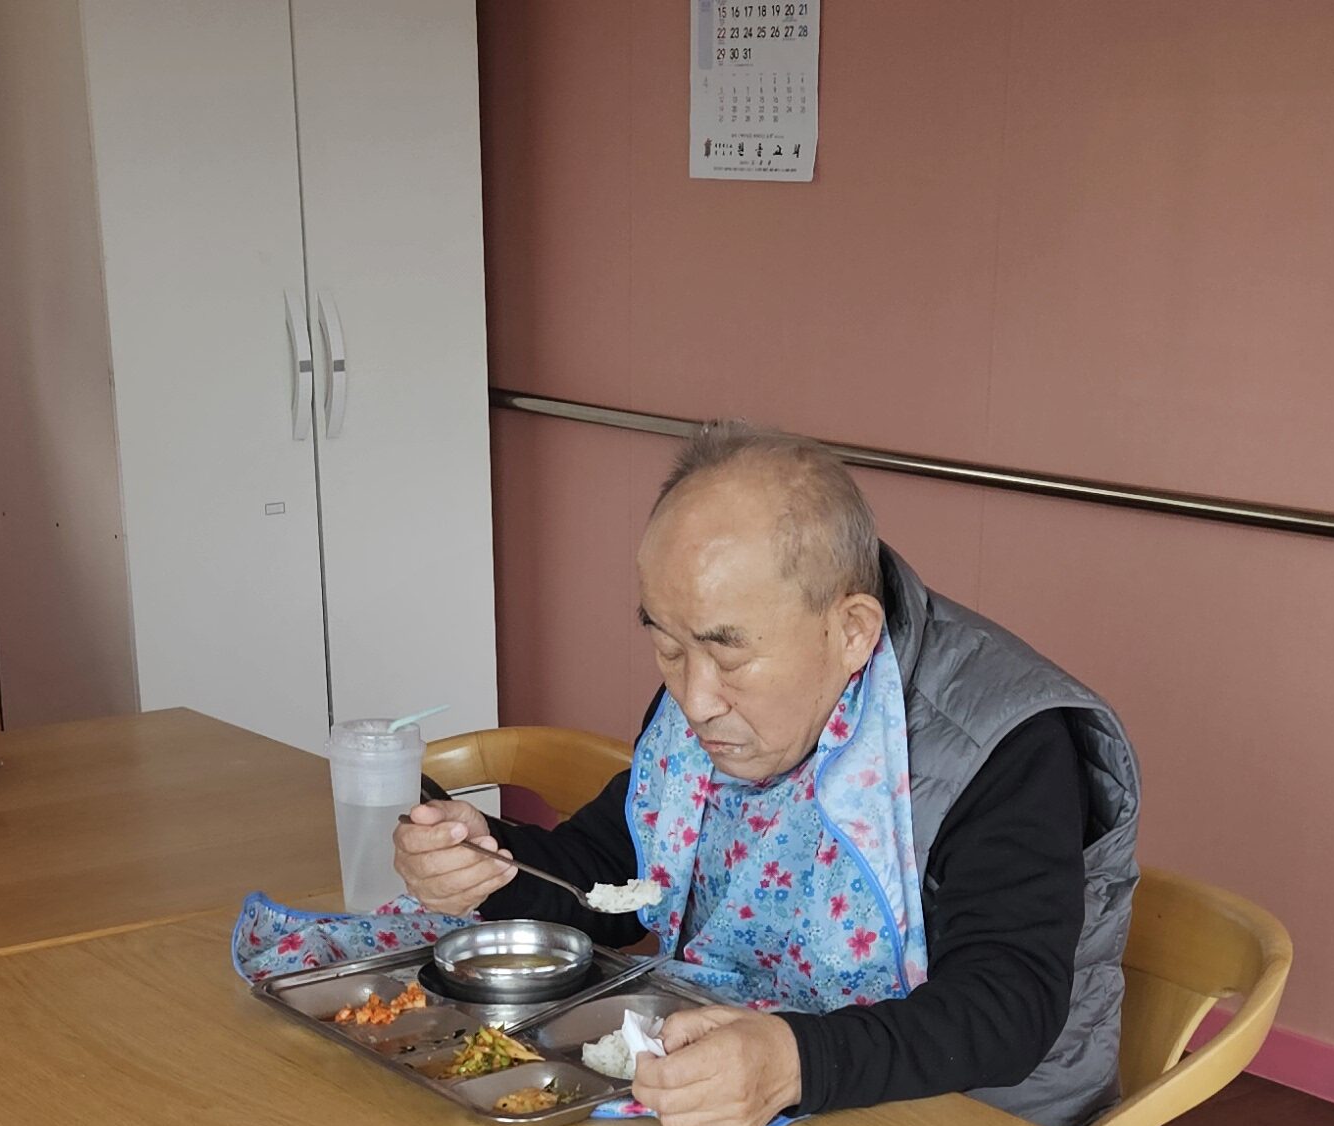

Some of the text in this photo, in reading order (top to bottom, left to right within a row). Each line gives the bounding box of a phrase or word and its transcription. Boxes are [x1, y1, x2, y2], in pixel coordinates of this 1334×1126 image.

[718, 4, 807, 18] 15 16 17 18 19 20 21
[717, 25, 808, 39] 22 23 24 25 26 27 28
[717, 48, 752, 60] 29 30 31
